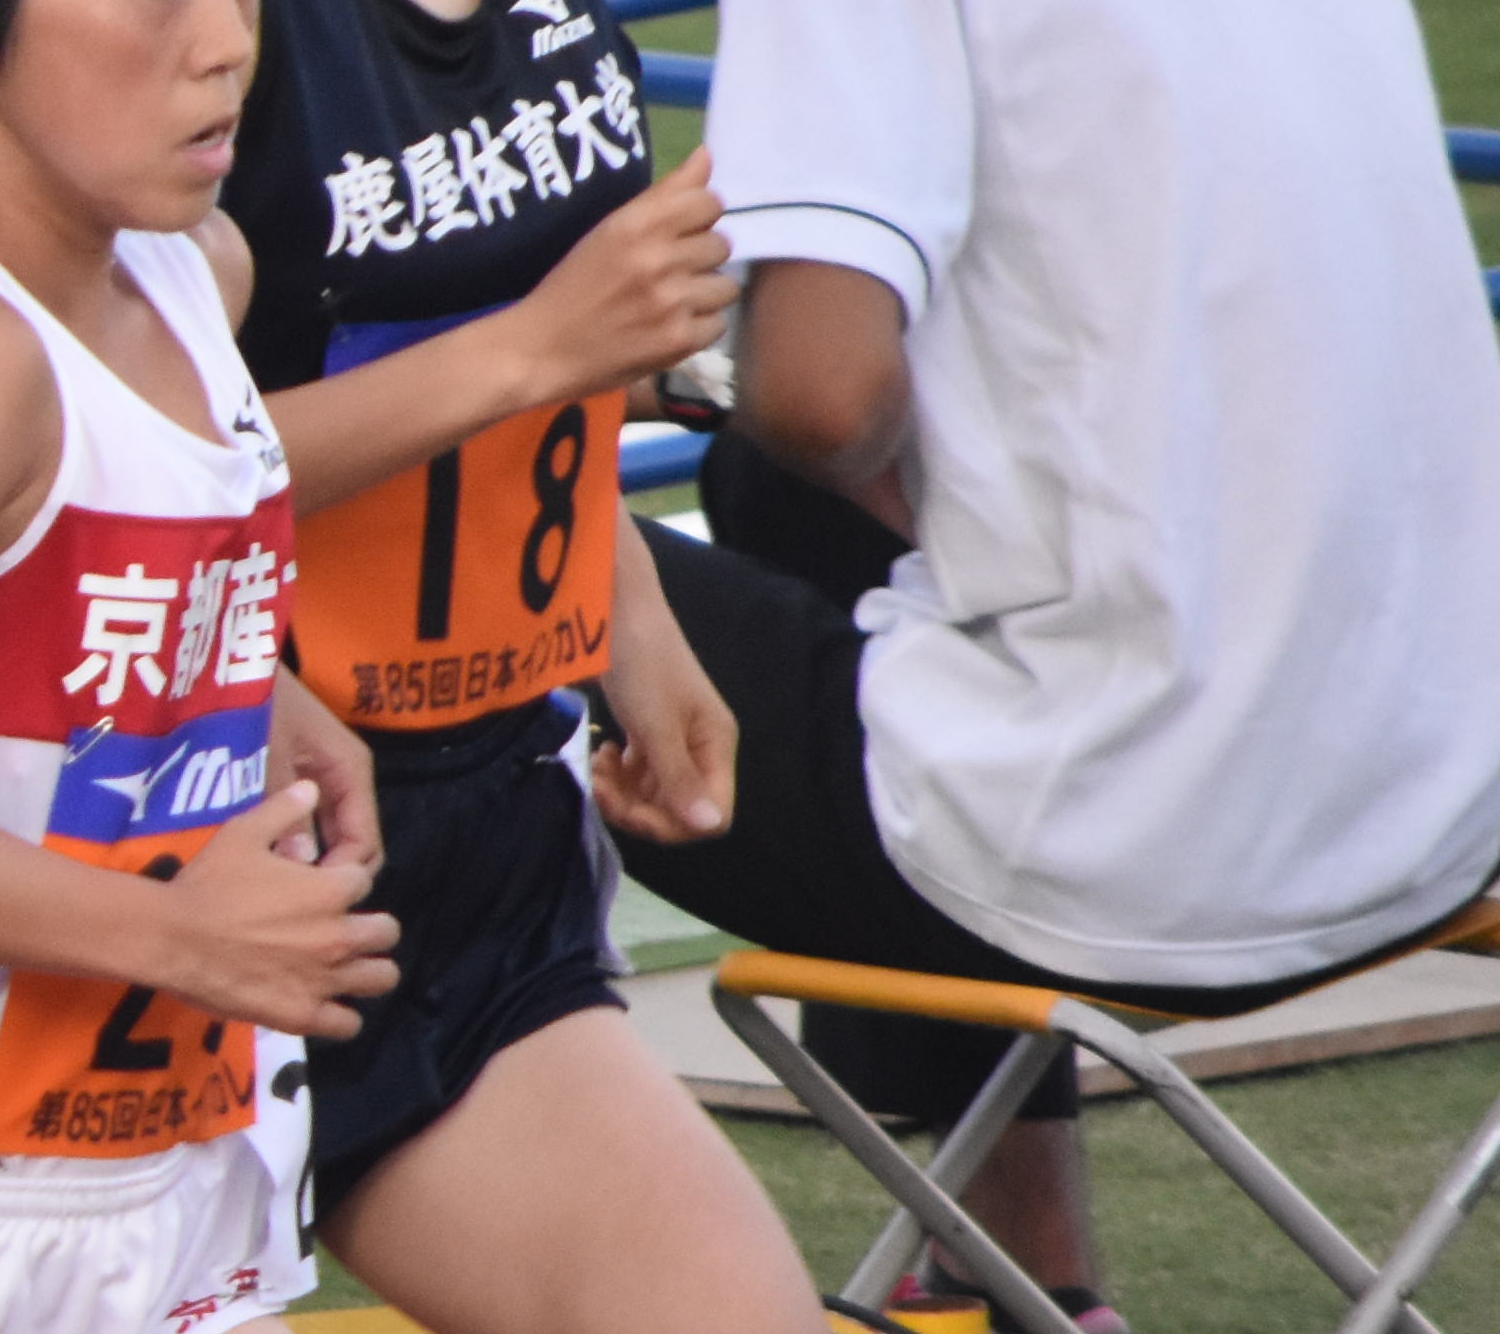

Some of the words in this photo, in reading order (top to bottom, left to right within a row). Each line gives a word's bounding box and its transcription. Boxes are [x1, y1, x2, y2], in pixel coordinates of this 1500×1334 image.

[324, 52, 645, 259] 鹿屋体育大学
[63, 541, 298, 706] 京都産
[416, 402, 587, 644] 18
